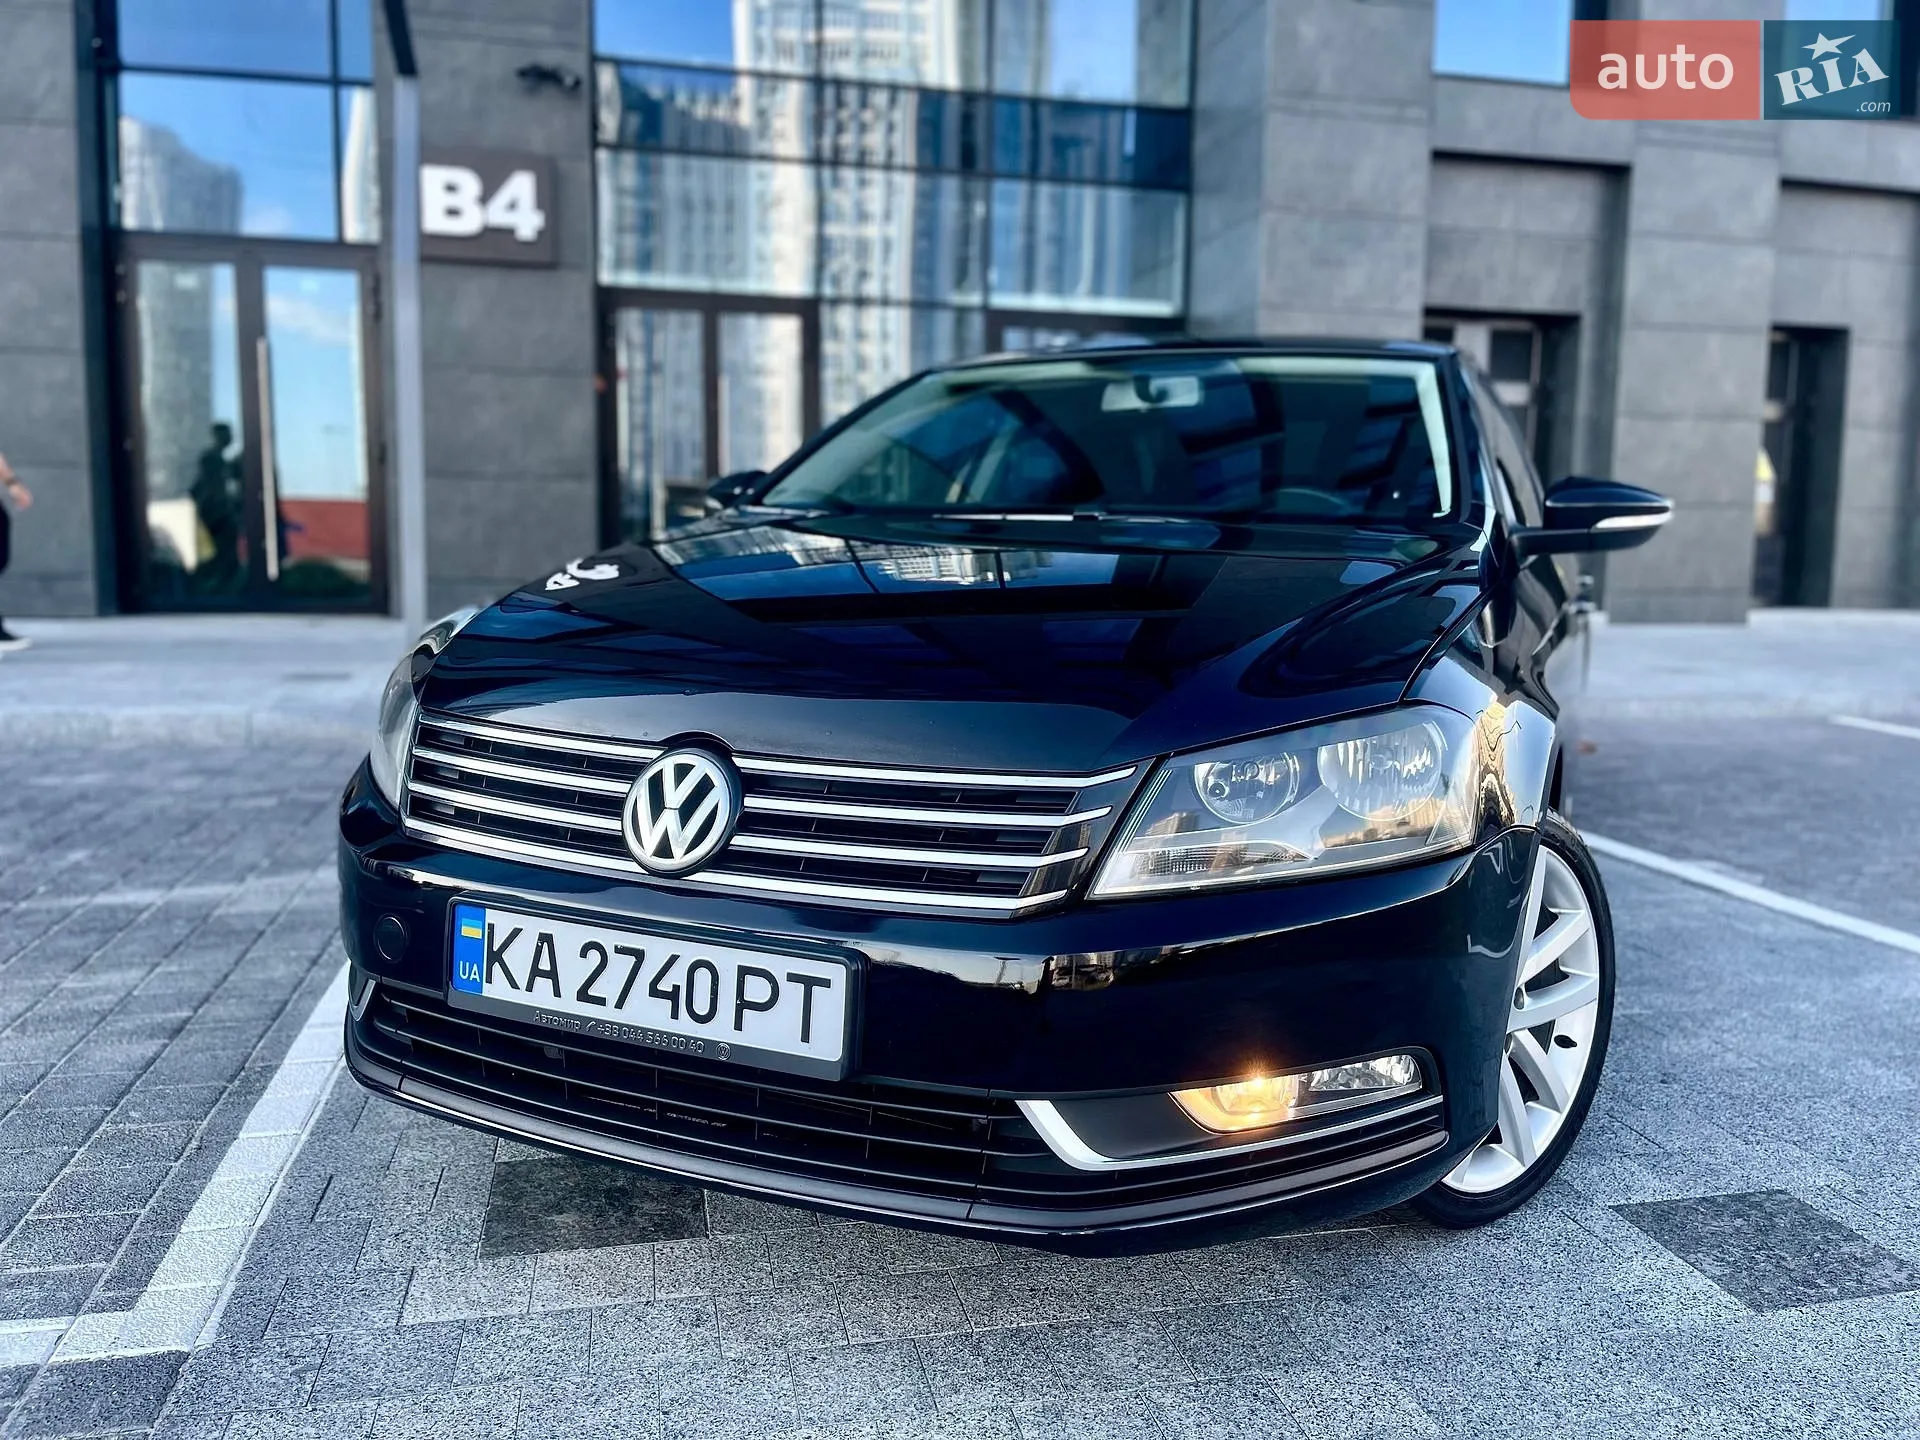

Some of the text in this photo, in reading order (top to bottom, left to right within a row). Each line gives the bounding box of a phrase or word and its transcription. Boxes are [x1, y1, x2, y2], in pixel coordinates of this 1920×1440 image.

[420, 163, 546, 242] B4
[459, 960, 481, 983] UA
[485, 922, 832, 1044] KA 2740 PT
[533, 1010, 582, 1032] Автомир
